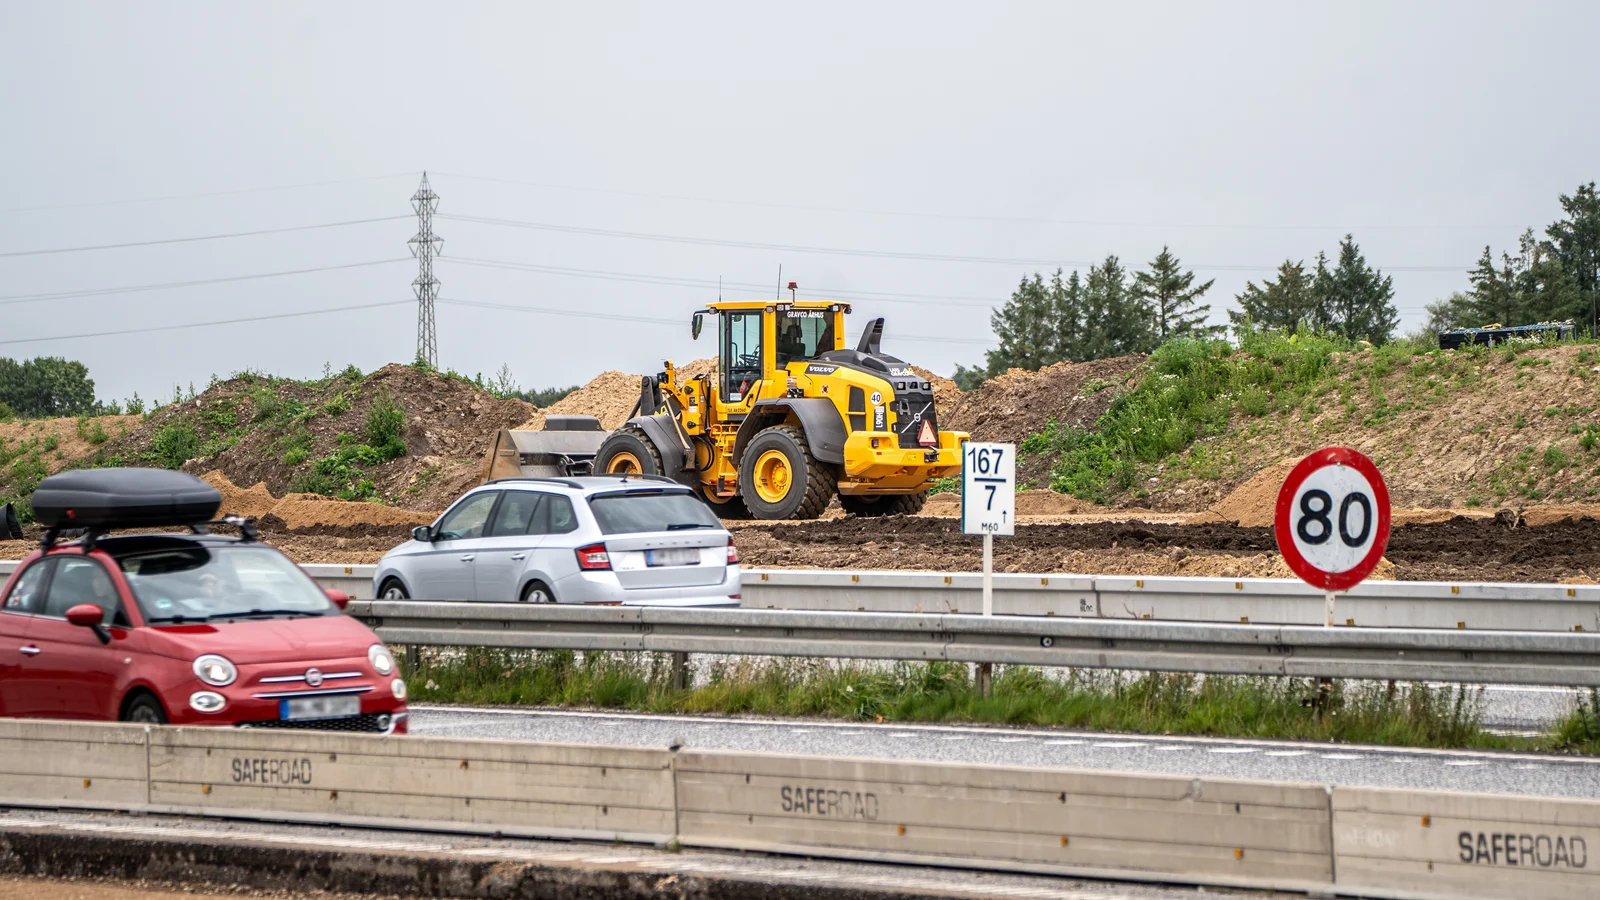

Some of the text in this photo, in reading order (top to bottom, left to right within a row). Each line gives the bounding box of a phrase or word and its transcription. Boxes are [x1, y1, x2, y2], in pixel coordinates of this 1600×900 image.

[808, 310, 824, 318] ÅRHUS
[809, 365, 835, 373] VOLVO
[871, 394, 881, 403] 40
[875, 412, 884, 428] L90H
[967, 447, 1004, 474] 167
[984, 485, 997, 511] 7
[981, 522, 999, 532] M60
[1297, 488, 1372, 548] 80
[232, 757, 312, 785] SAFEROAD
[781, 785, 879, 821] SAFEROAD
[1458, 831, 1588, 869] SAFEROAD
